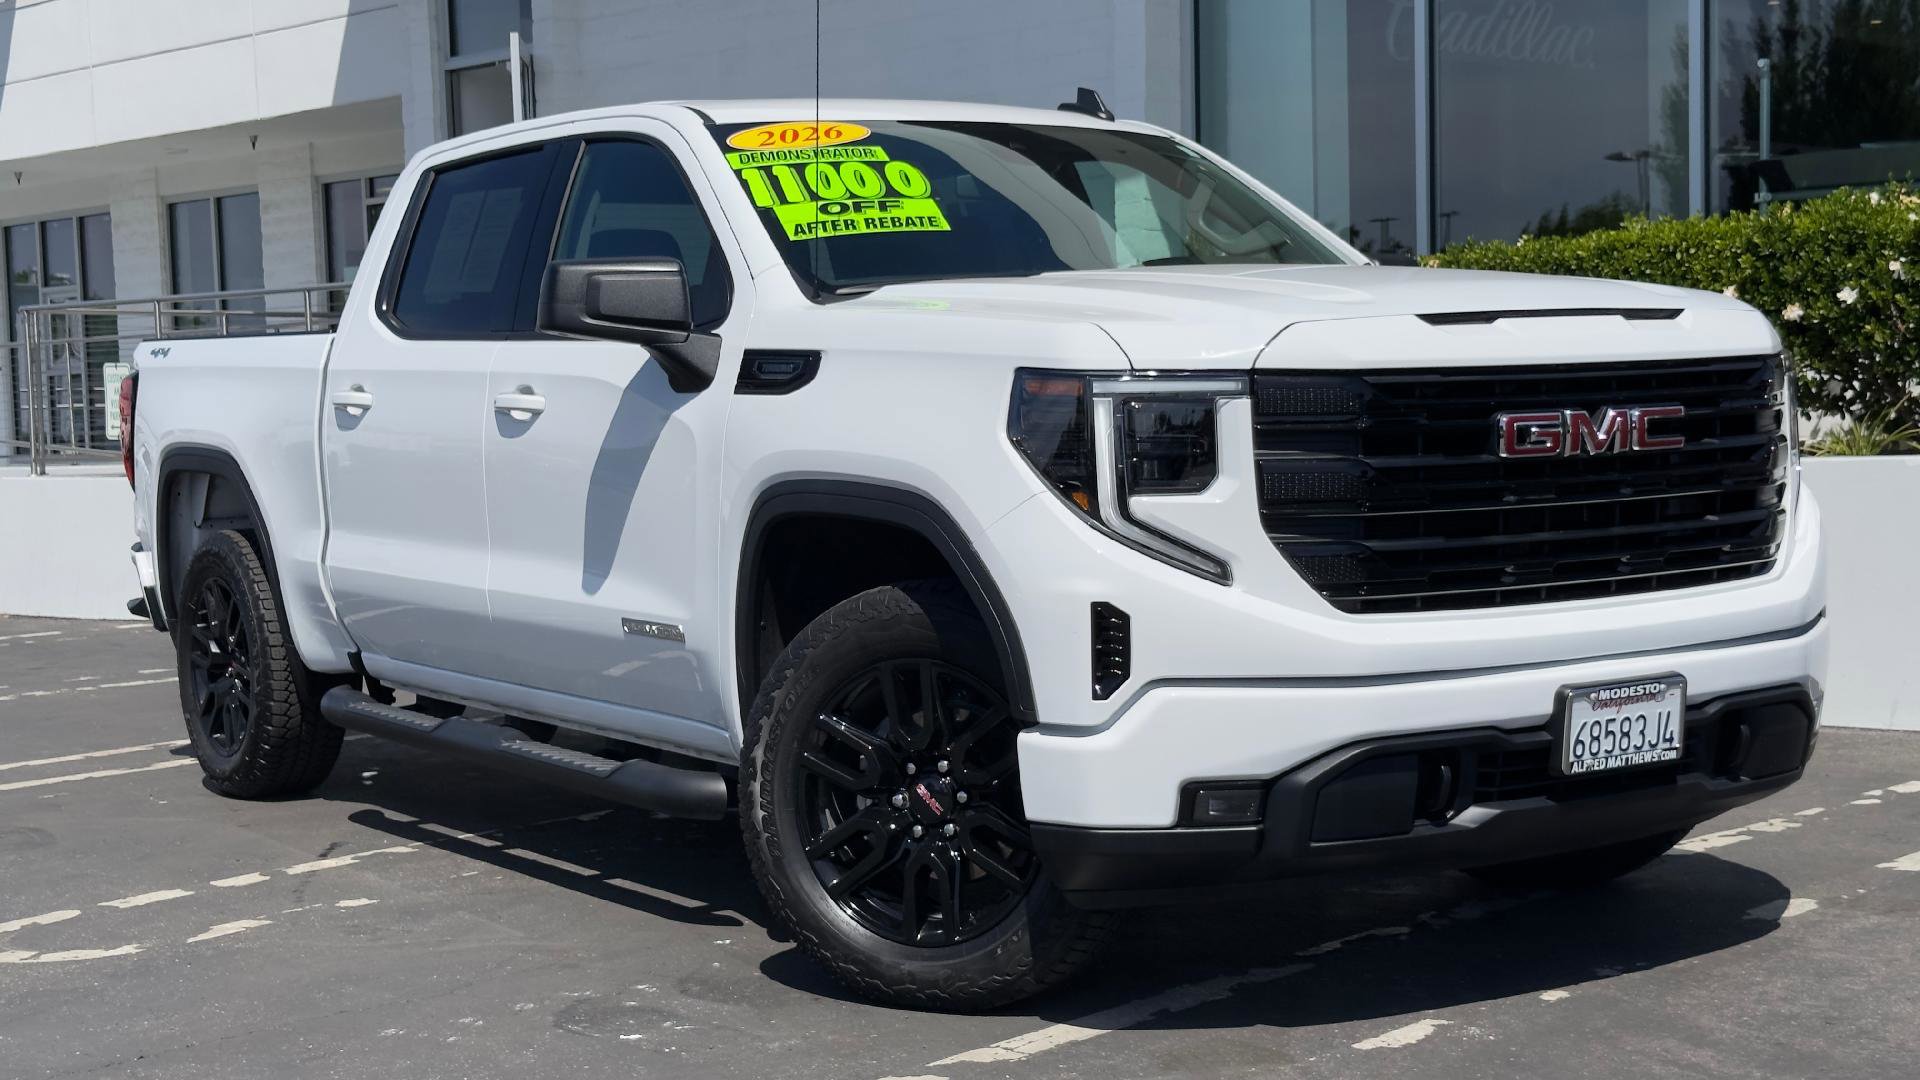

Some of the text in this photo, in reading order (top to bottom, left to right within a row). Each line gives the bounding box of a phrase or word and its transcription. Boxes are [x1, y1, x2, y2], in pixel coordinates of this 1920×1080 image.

[757, 125, 843, 148] 2026
[739, 147, 877, 165] DEMONSTRATOR
[818, 200, 905, 216] OFF
[793, 216, 940, 237] AFTER REBATE
[1498, 405, 1686, 457] GMC
[1599, 683, 1660, 700] MODESTO
[1572, 710, 1675, 760] 68583J4
[1571, 758, 1607, 774] ALFRED
[915, 783, 944, 816] GMC
